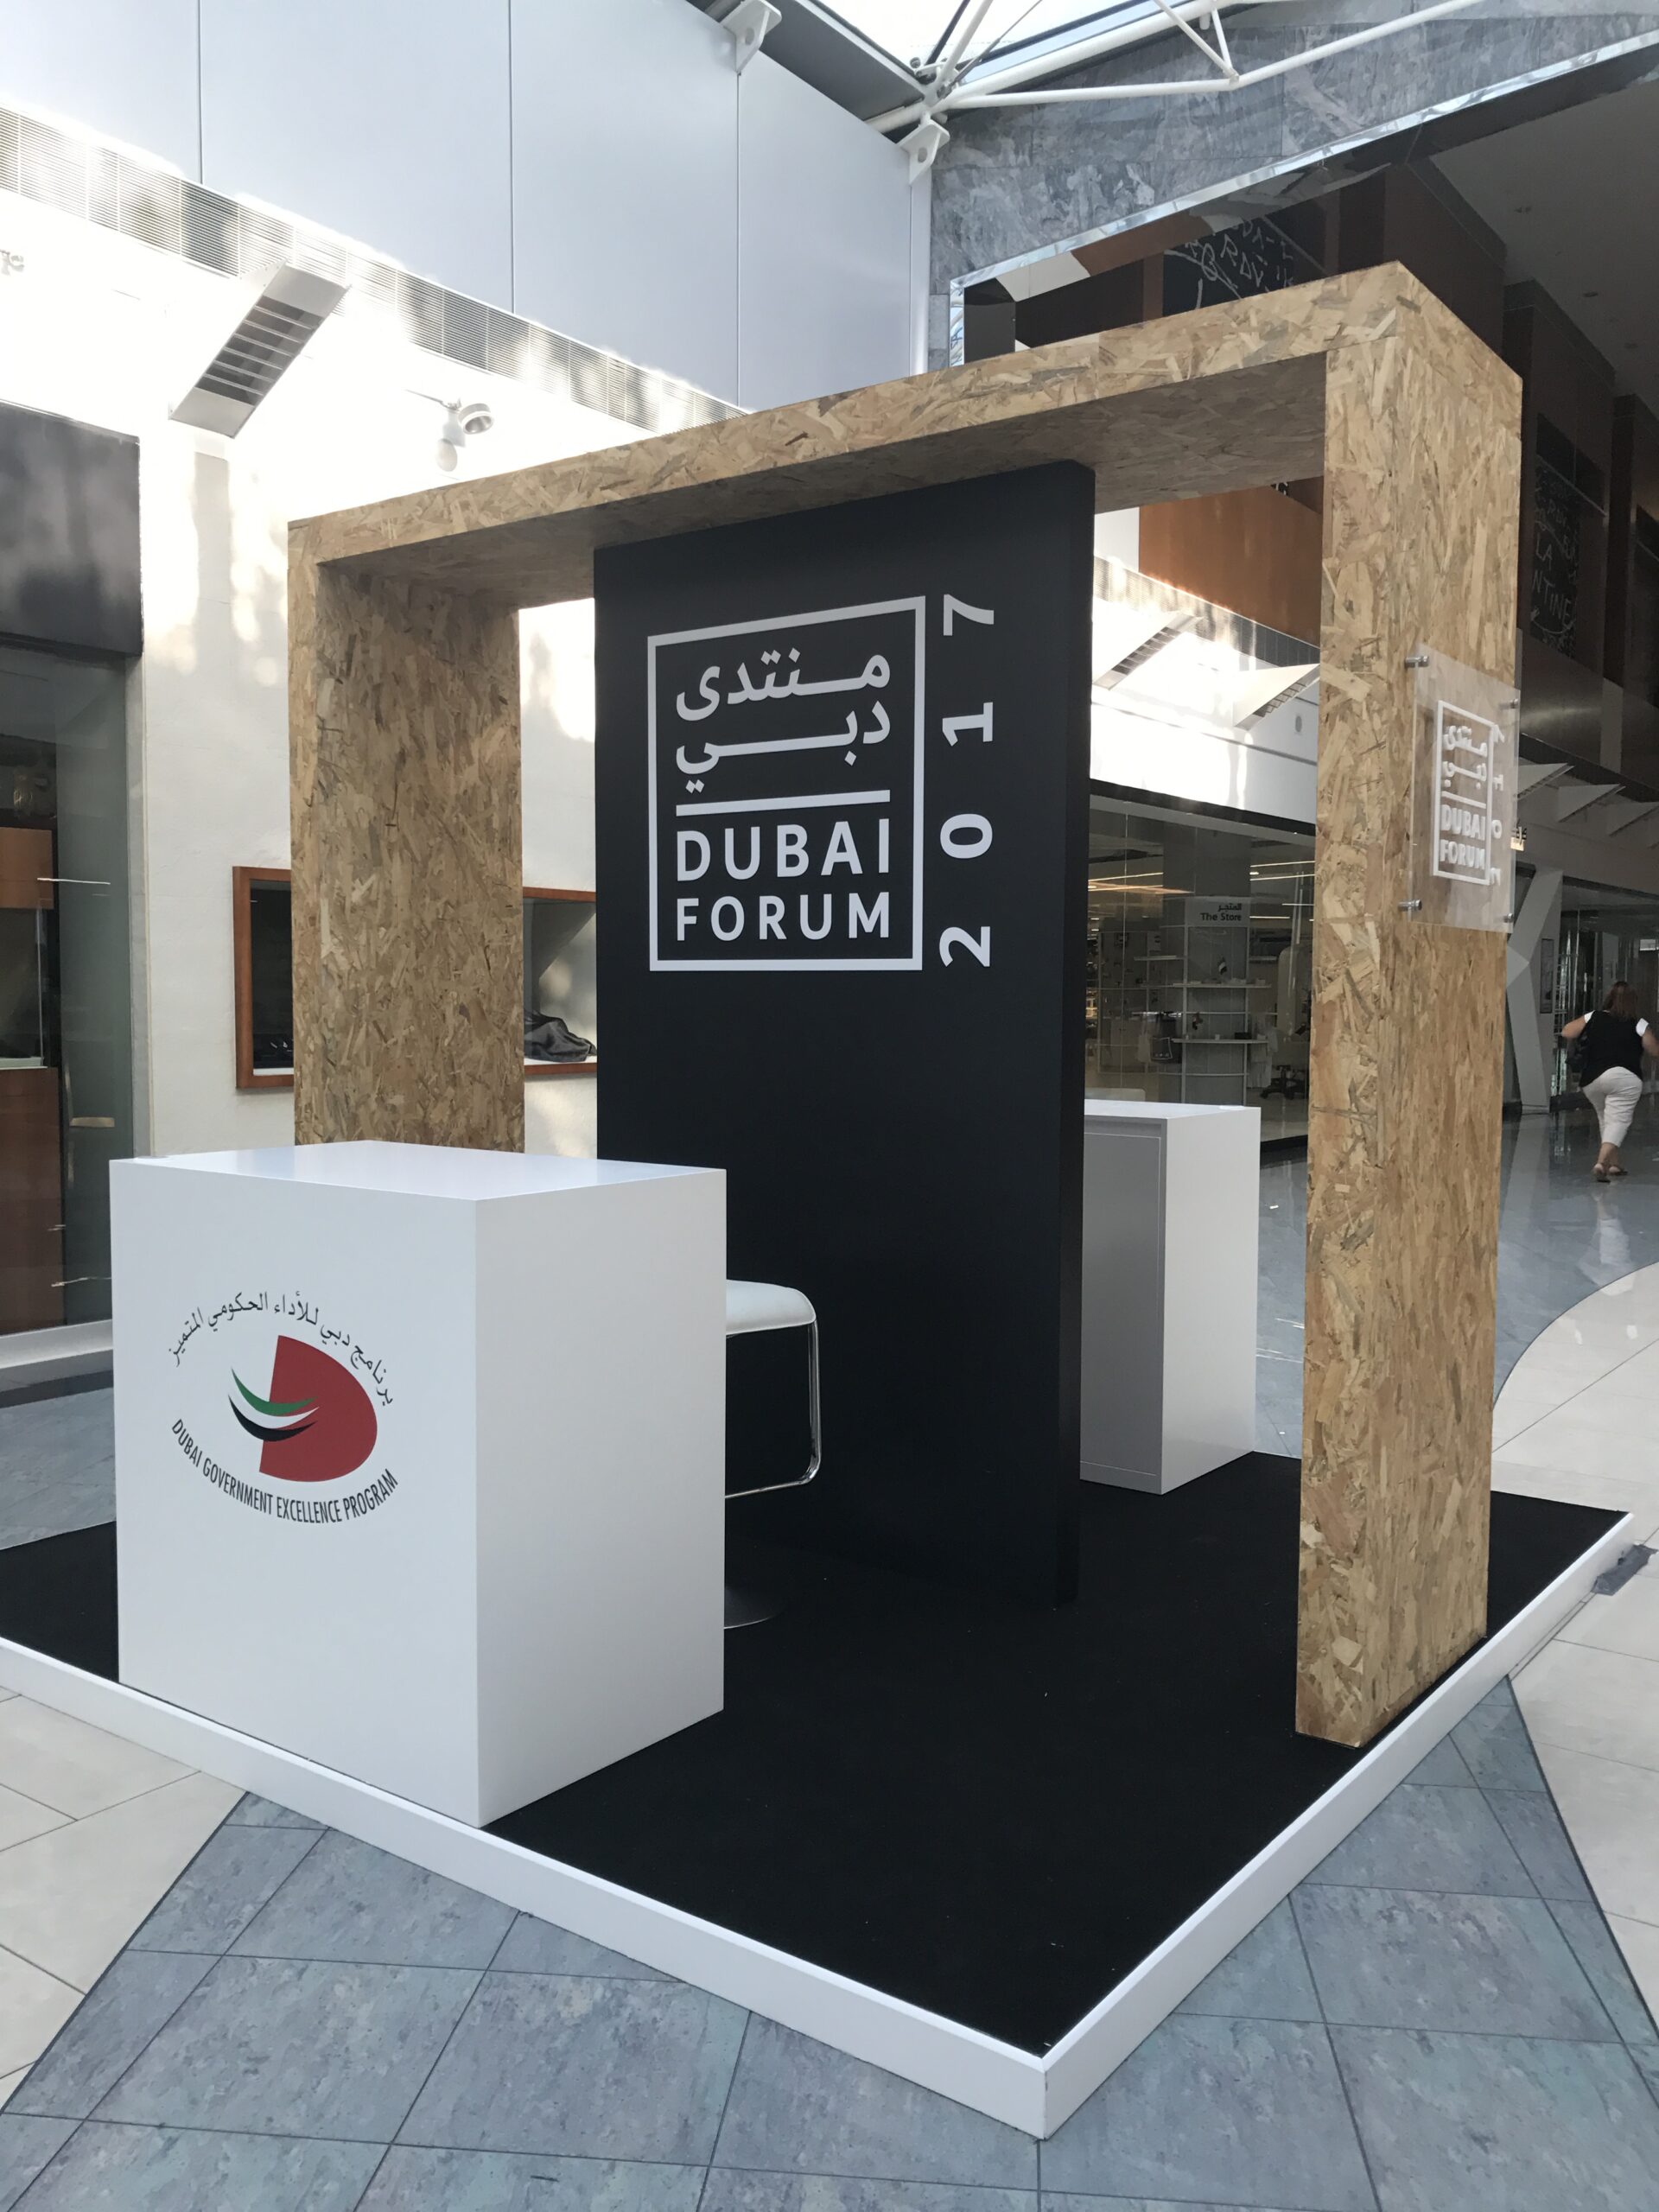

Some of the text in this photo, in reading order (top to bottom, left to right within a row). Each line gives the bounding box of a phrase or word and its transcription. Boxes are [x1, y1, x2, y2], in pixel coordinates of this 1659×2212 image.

[676, 647, 891, 721] منتدى
[676, 701, 891, 793] دبي
[938, 594, 995, 968] 2017
[677, 818, 890, 881] DUBAI
[1440, 804, 1486, 842] DUBAI
[1440, 839, 1485, 870] FORUM
[677, 892, 890, 942] FORUM
[1200, 912, 1243, 921] The Store
[168, 1290, 394, 1407] برنامج دبي للأداء الحكومي المتميز
[171, 1418, 399, 1524] DUBAI GOVERNMENT EXCELLENCE PROGRAM
